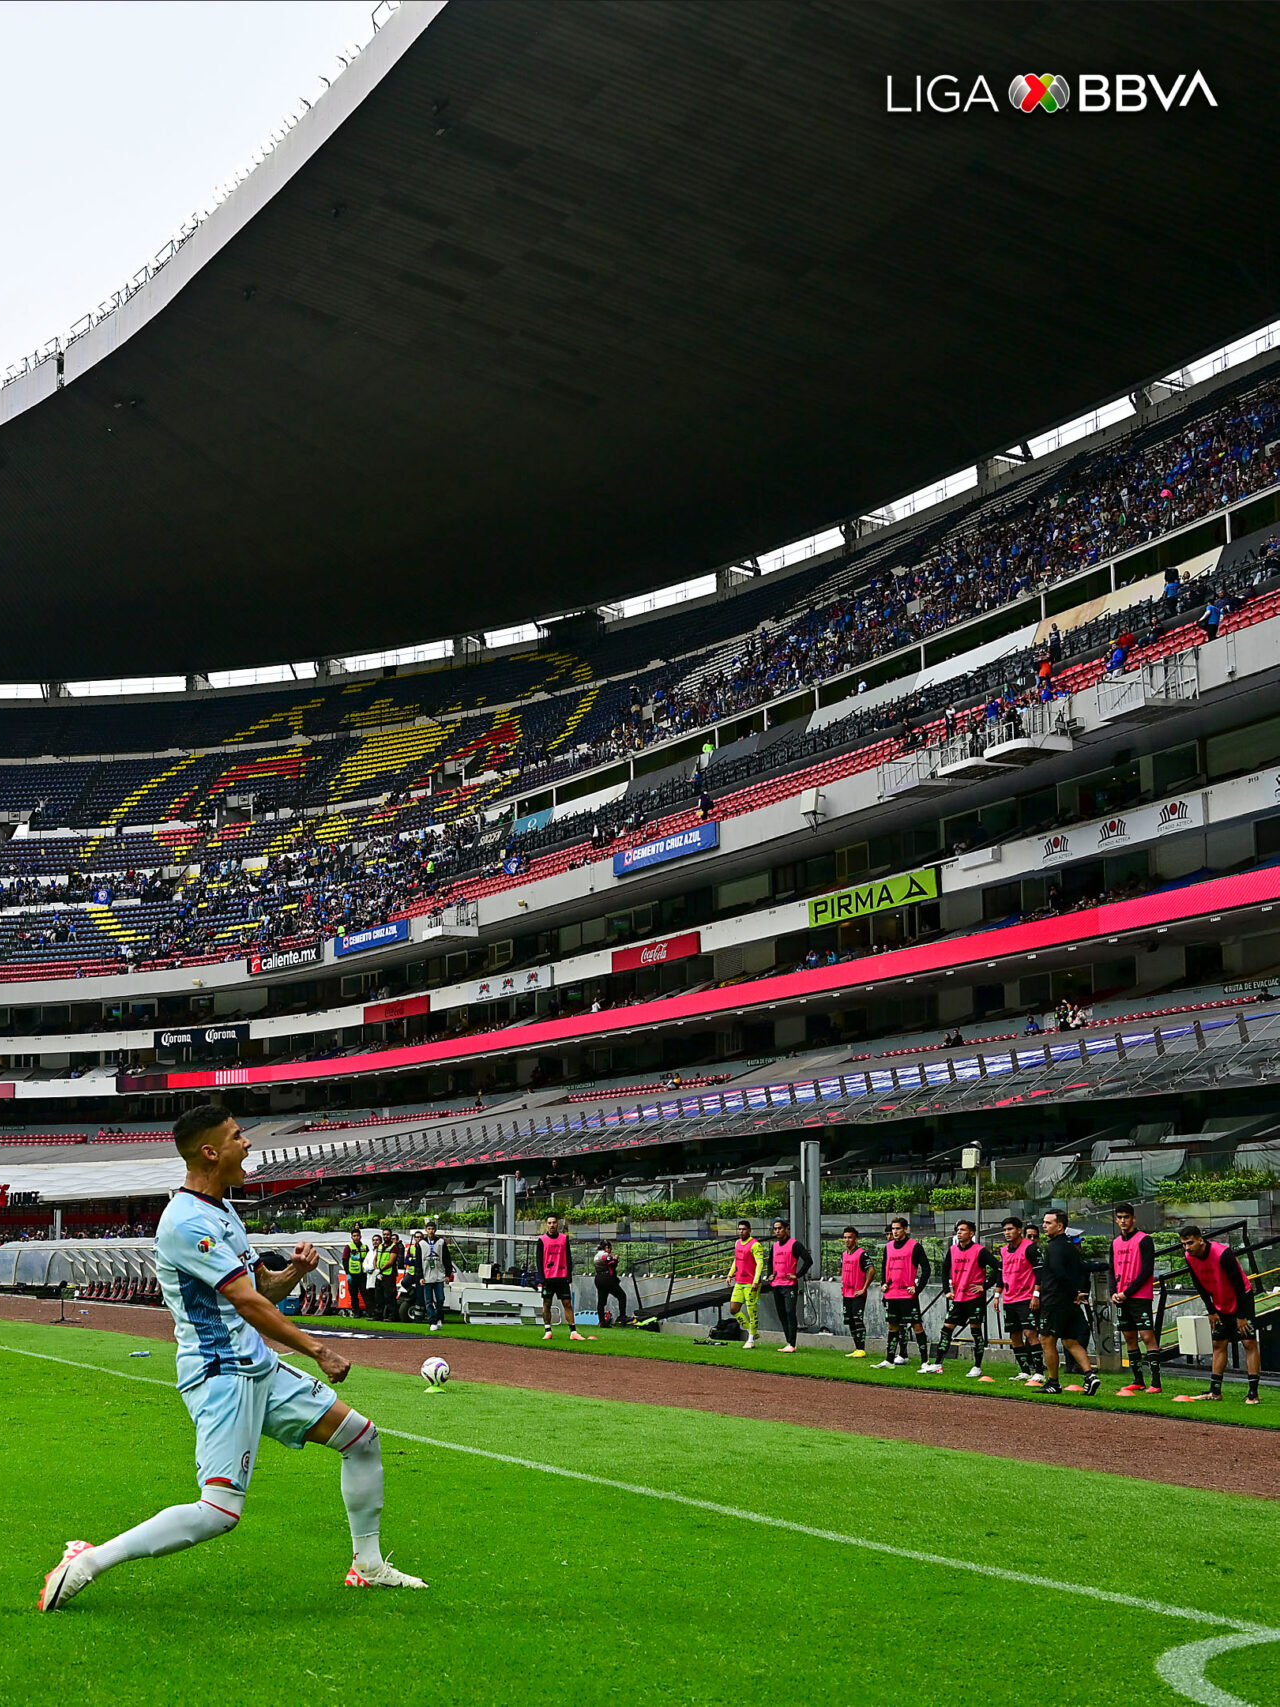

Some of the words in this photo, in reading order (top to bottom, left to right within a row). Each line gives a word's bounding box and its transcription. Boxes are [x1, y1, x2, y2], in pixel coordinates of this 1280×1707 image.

[633, 841, 665, 861] CEMENTO
[665, 836, 685, 851] CRUZ
[683, 830, 702, 846] AZUL
[813, 883, 895, 923] PIRMA
[349, 933, 371, 947] CEMENTO
[372, 929, 385, 940] CRUZ
[384, 924, 398, 938] AZUL
[261, 948, 317, 971] caliente.mx
[1244, 981, 1253, 990] DE
[161, 1032, 192, 1047] Corona
[205, 1028, 237, 1044] Corona
